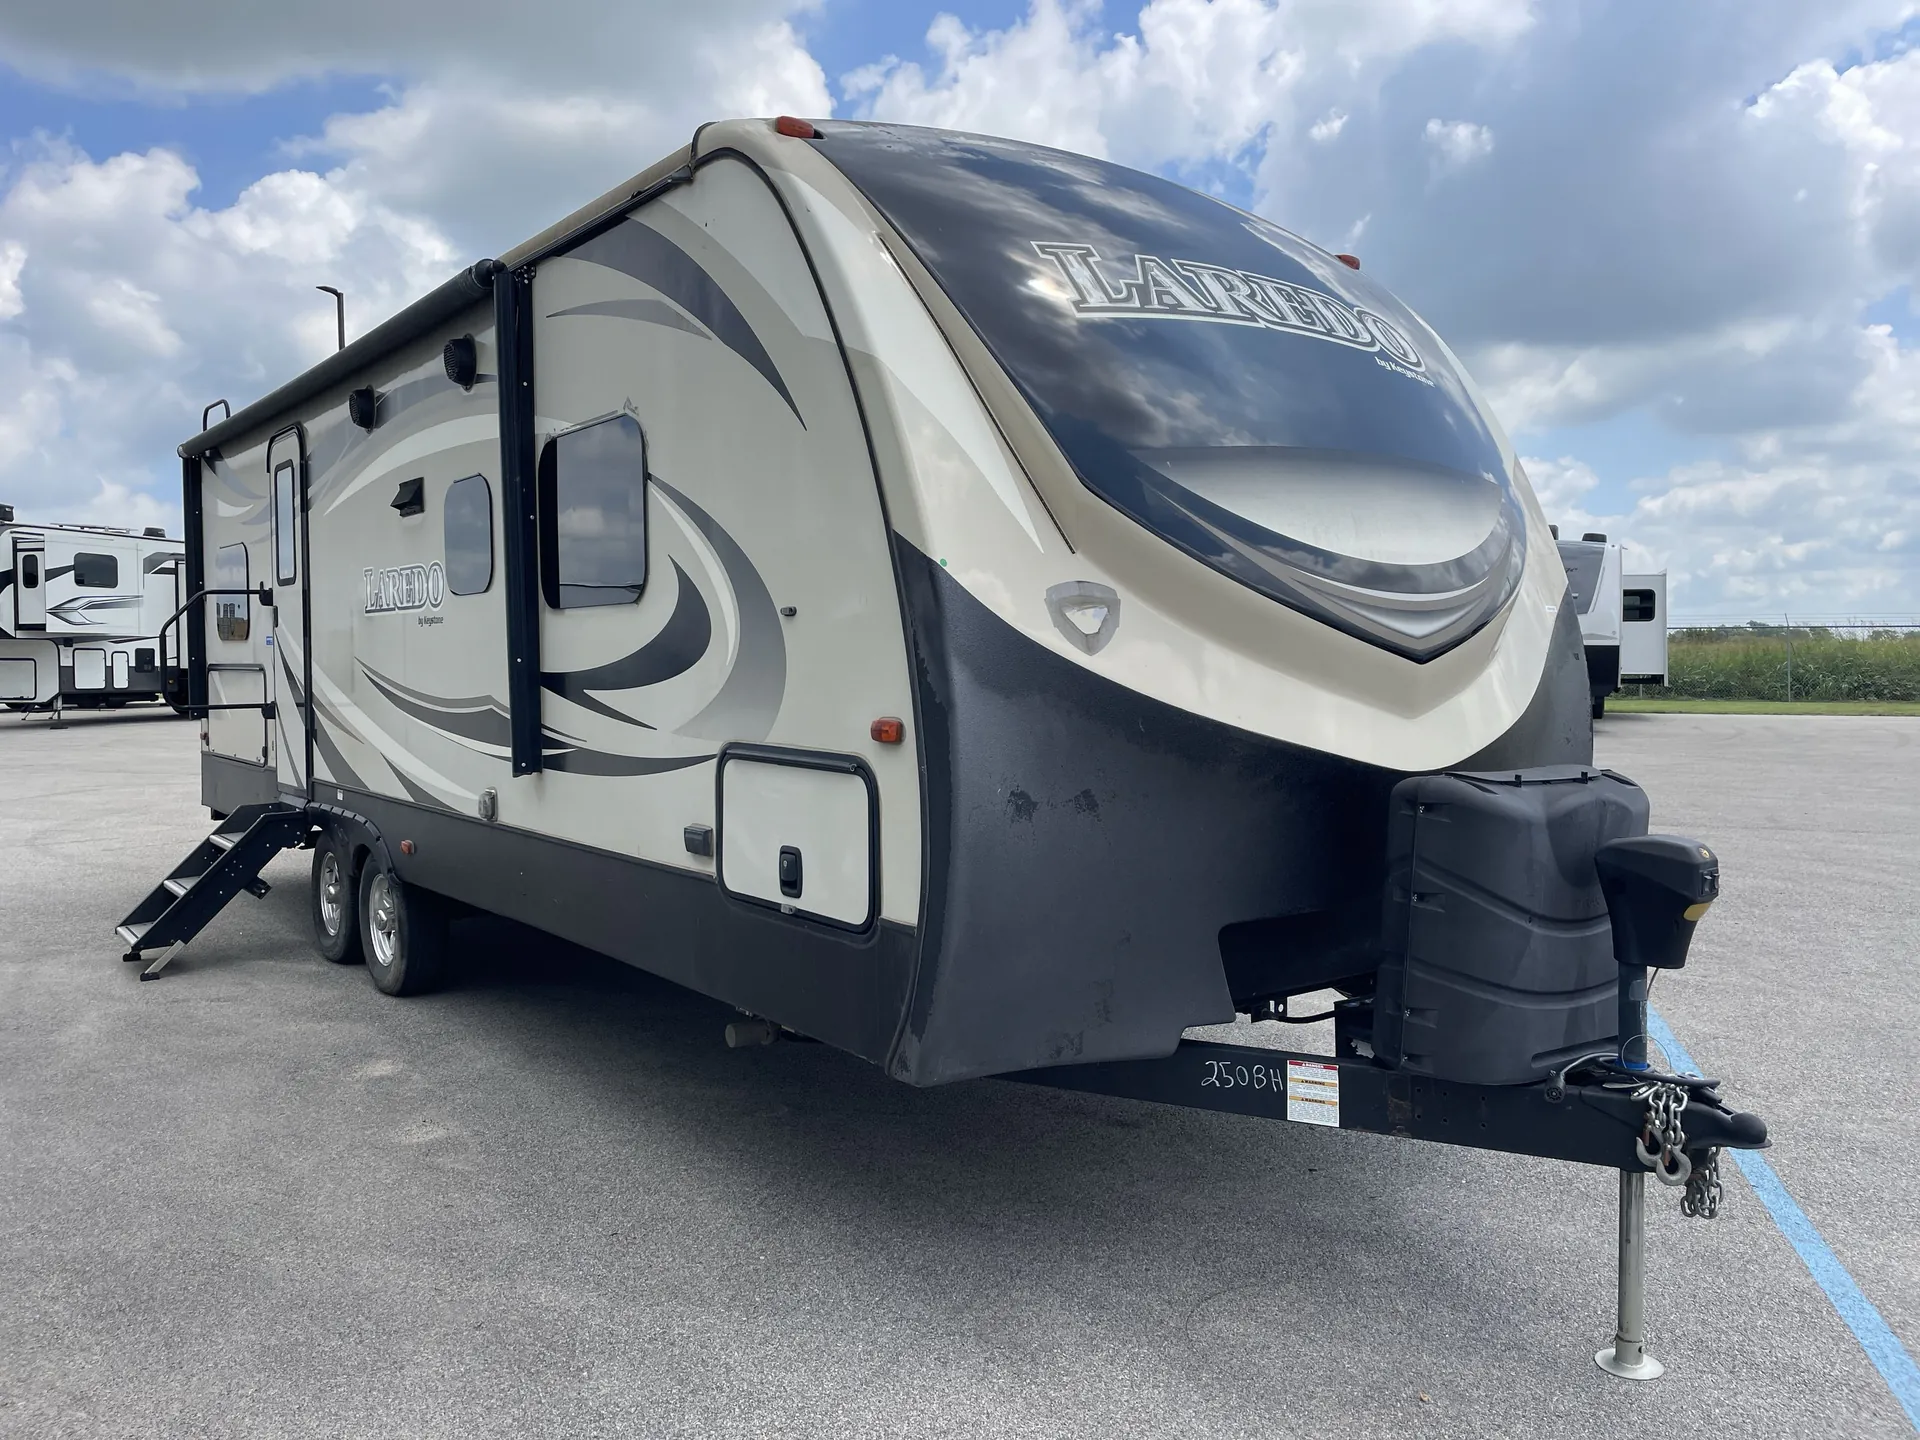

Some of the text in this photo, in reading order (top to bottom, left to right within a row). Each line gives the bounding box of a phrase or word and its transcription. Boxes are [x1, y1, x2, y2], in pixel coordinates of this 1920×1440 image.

[1030, 241, 1425, 372] LAREDO
[1374, 356, 1391, 371] by
[364, 560, 444, 615] LAREDO
[1201, 1061, 1283, 1092] 250BH
